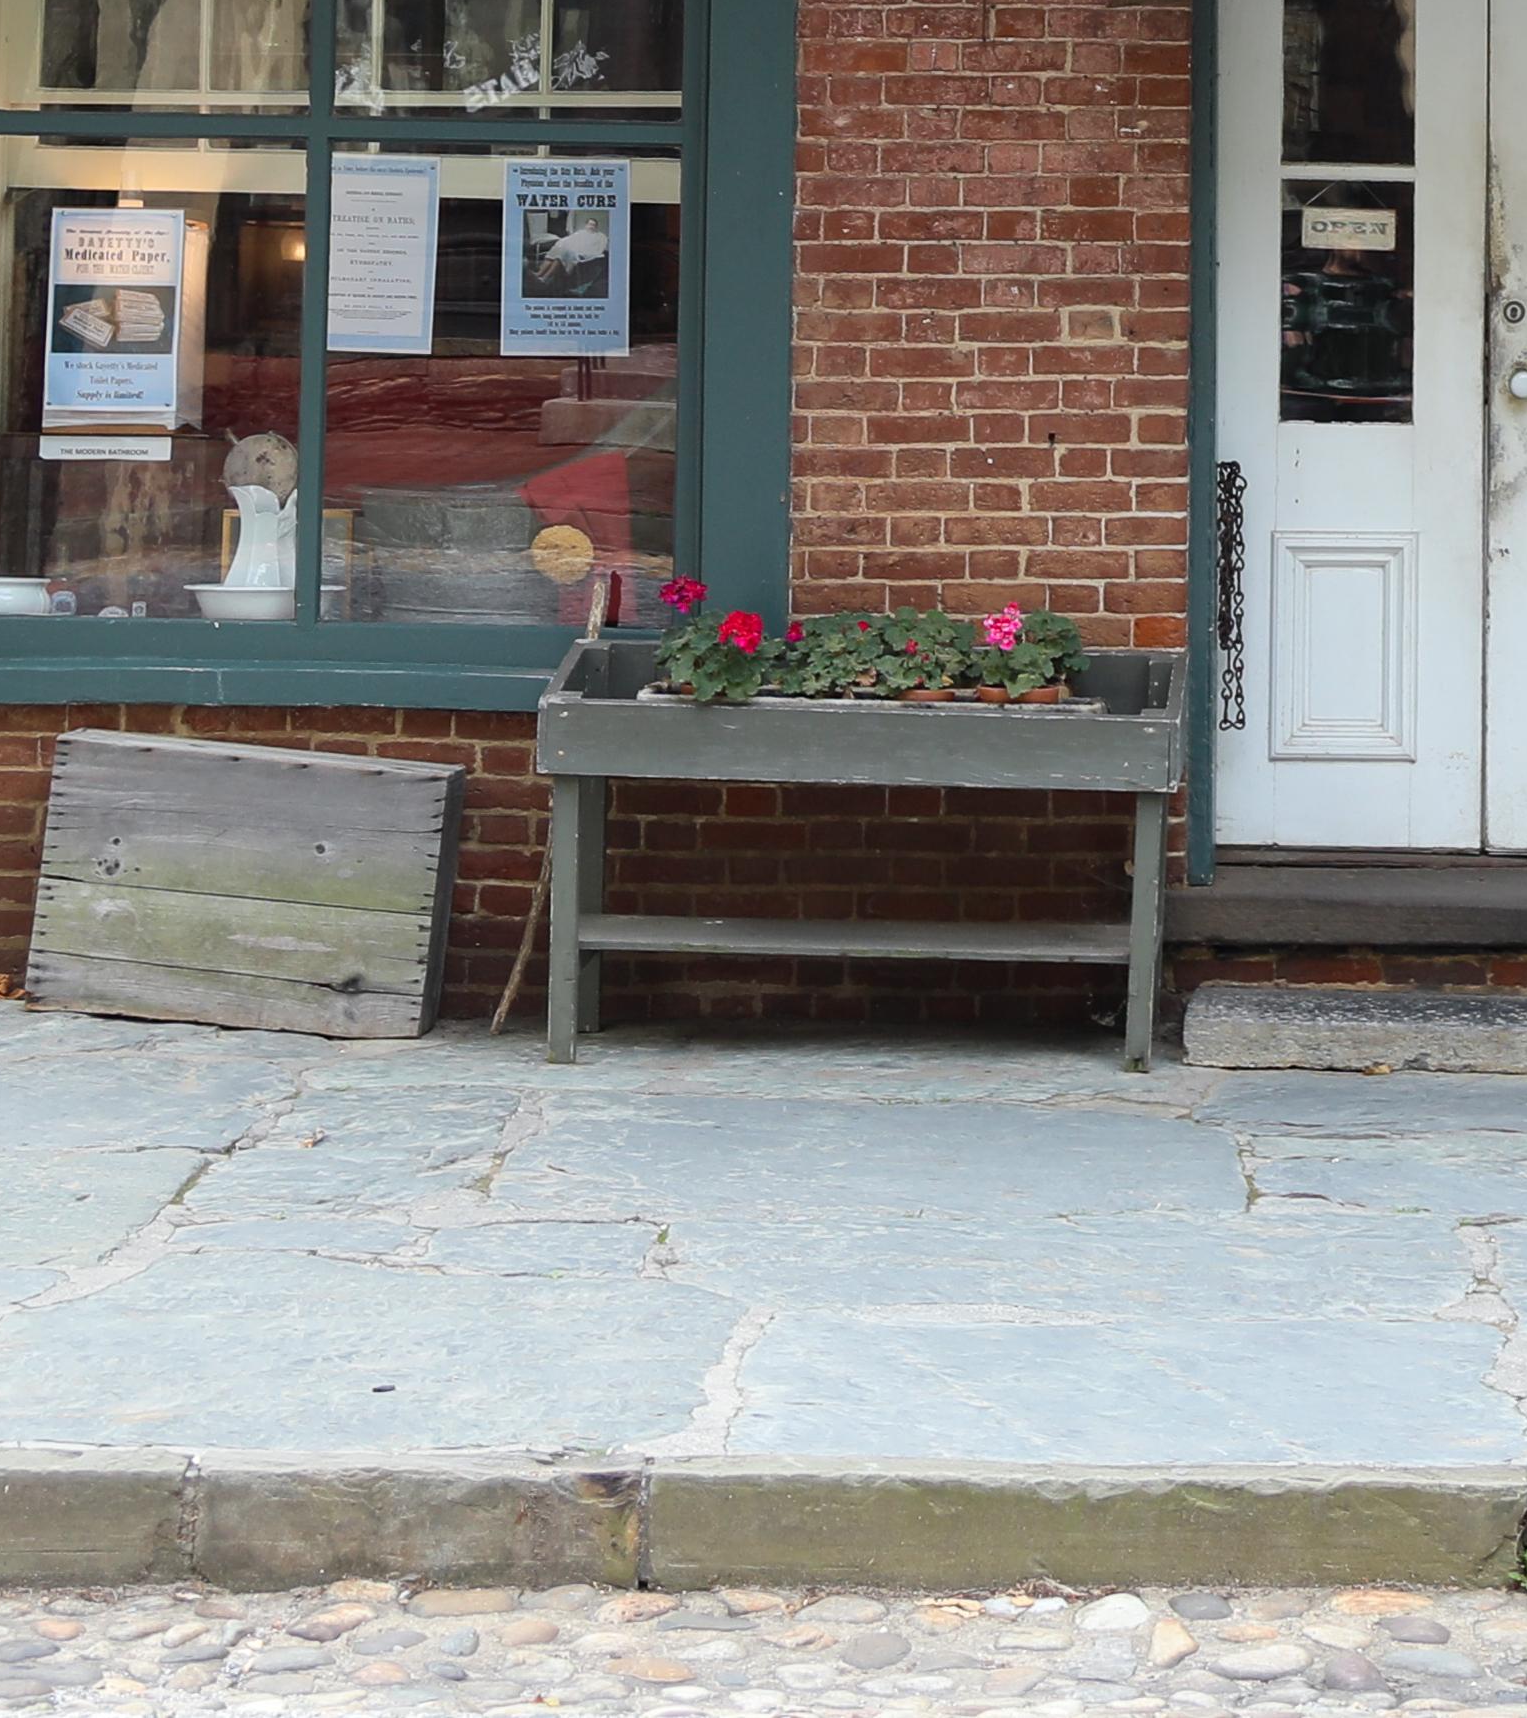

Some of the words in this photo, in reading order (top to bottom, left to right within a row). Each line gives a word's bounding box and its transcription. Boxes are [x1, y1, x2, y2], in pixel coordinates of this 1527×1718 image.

[516, 194, 569, 207] WATER
[576, 194, 616, 208] CURE
[1311, 220, 1388, 236] OPEN
[64, 248, 123, 261] Medicated
[64, 361, 74, 369] We
[76, 361, 93, 369] stock
[127, 362, 158, 370] Medicated
[77, 390, 103, 401] Supply
[105, 391, 112, 399] is
